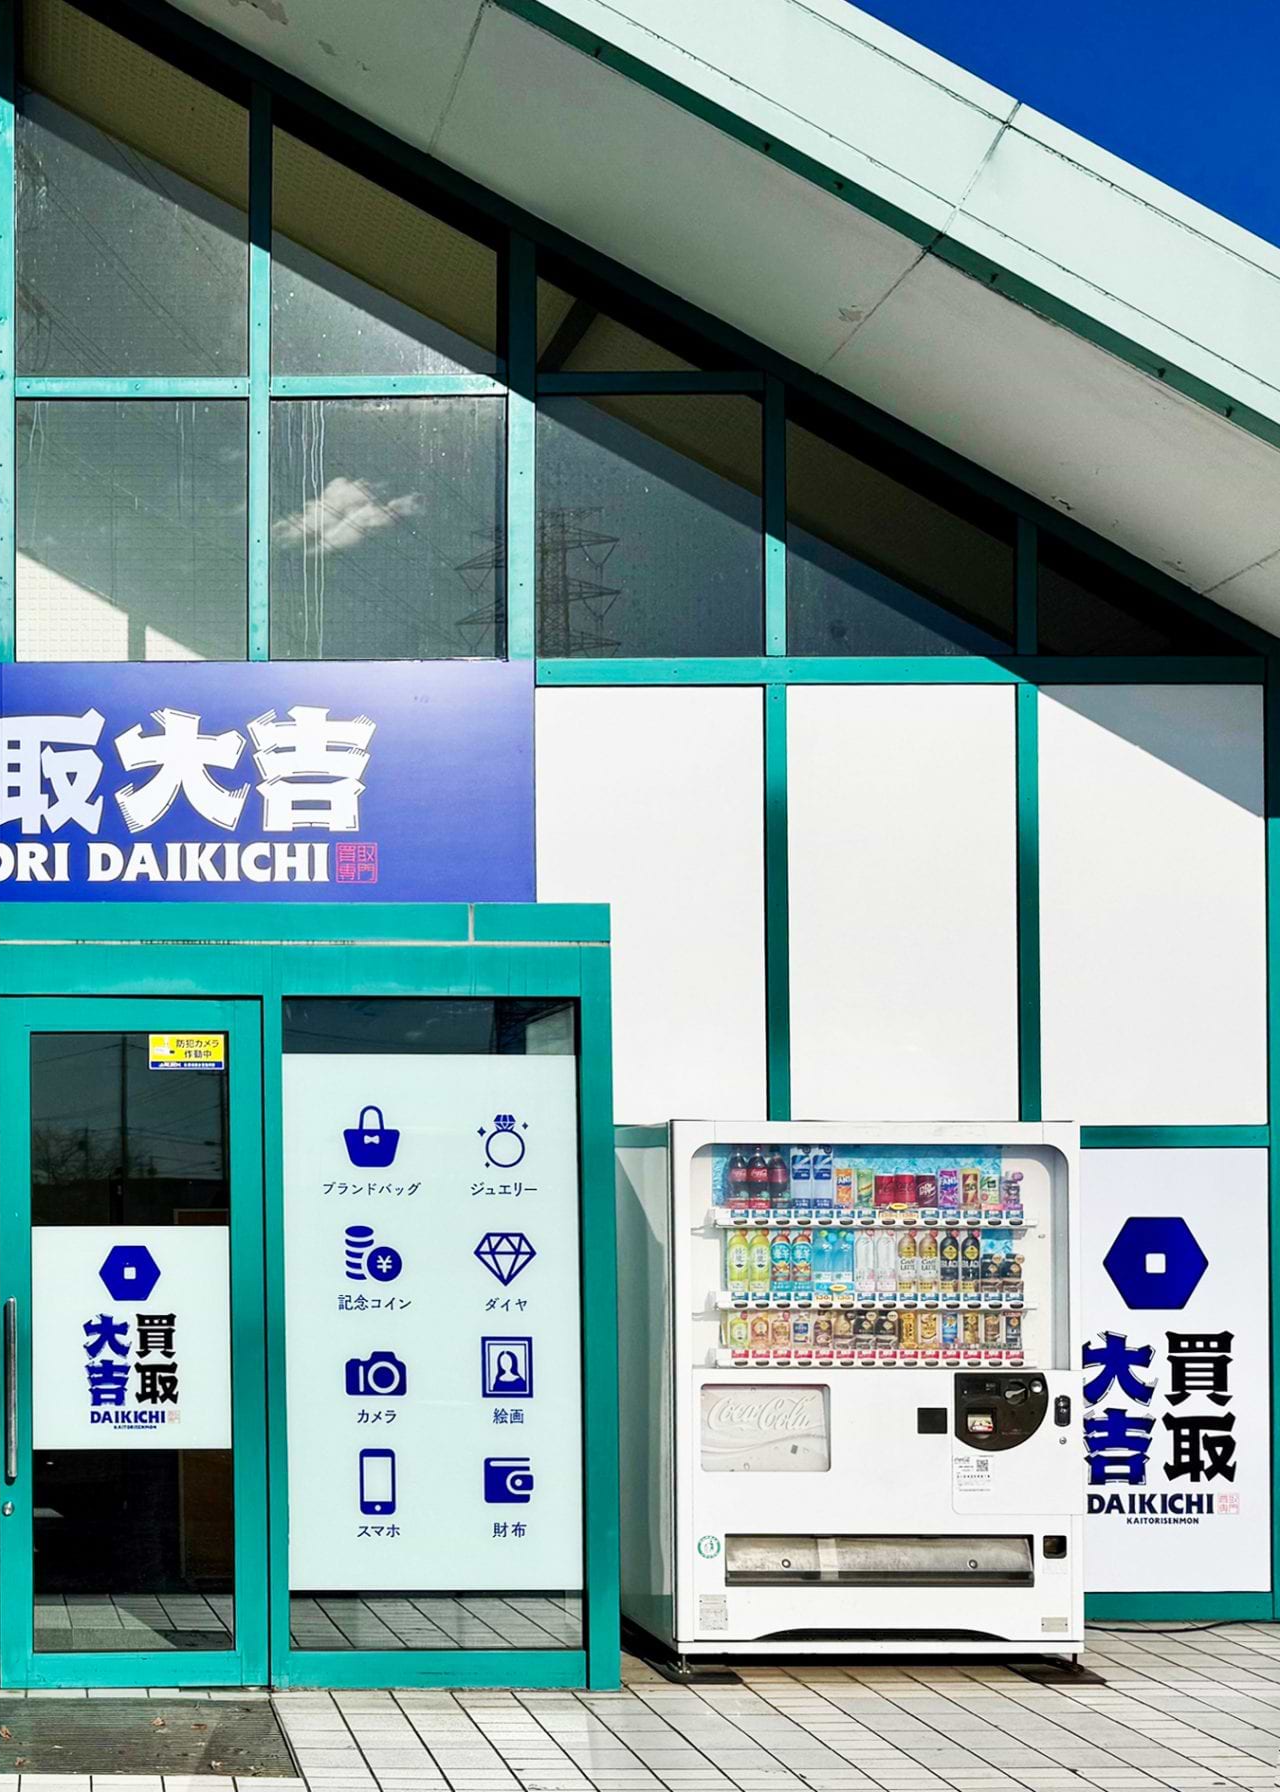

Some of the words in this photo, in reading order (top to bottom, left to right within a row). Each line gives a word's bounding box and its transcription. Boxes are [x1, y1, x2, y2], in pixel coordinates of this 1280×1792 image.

[88, 843, 329, 881] DAIKICHI
[323, 1182, 421, 1196] ブランドバッグ
[471, 1182, 537, 1197] ジュエリー
[338, 1294, 411, 1311] 記念コイン
[486, 1298, 527, 1311] ダイヤ
[83, 1314, 131, 1406] 大吉
[135, 1314, 178, 1404] 買取
[1082, 1331, 1156, 1485] 大吉
[1162, 1331, 1236, 1482] 買取
[91, 1411, 165, 1423] DAIKICHI
[357, 1409, 396, 1423] カメラ
[493, 1408, 524, 1424] 絵画
[1087, 1494, 1213, 1514] DAIKICHI
[357, 1524, 400, 1538] スマホ
[493, 1522, 527, 1538] 財布
